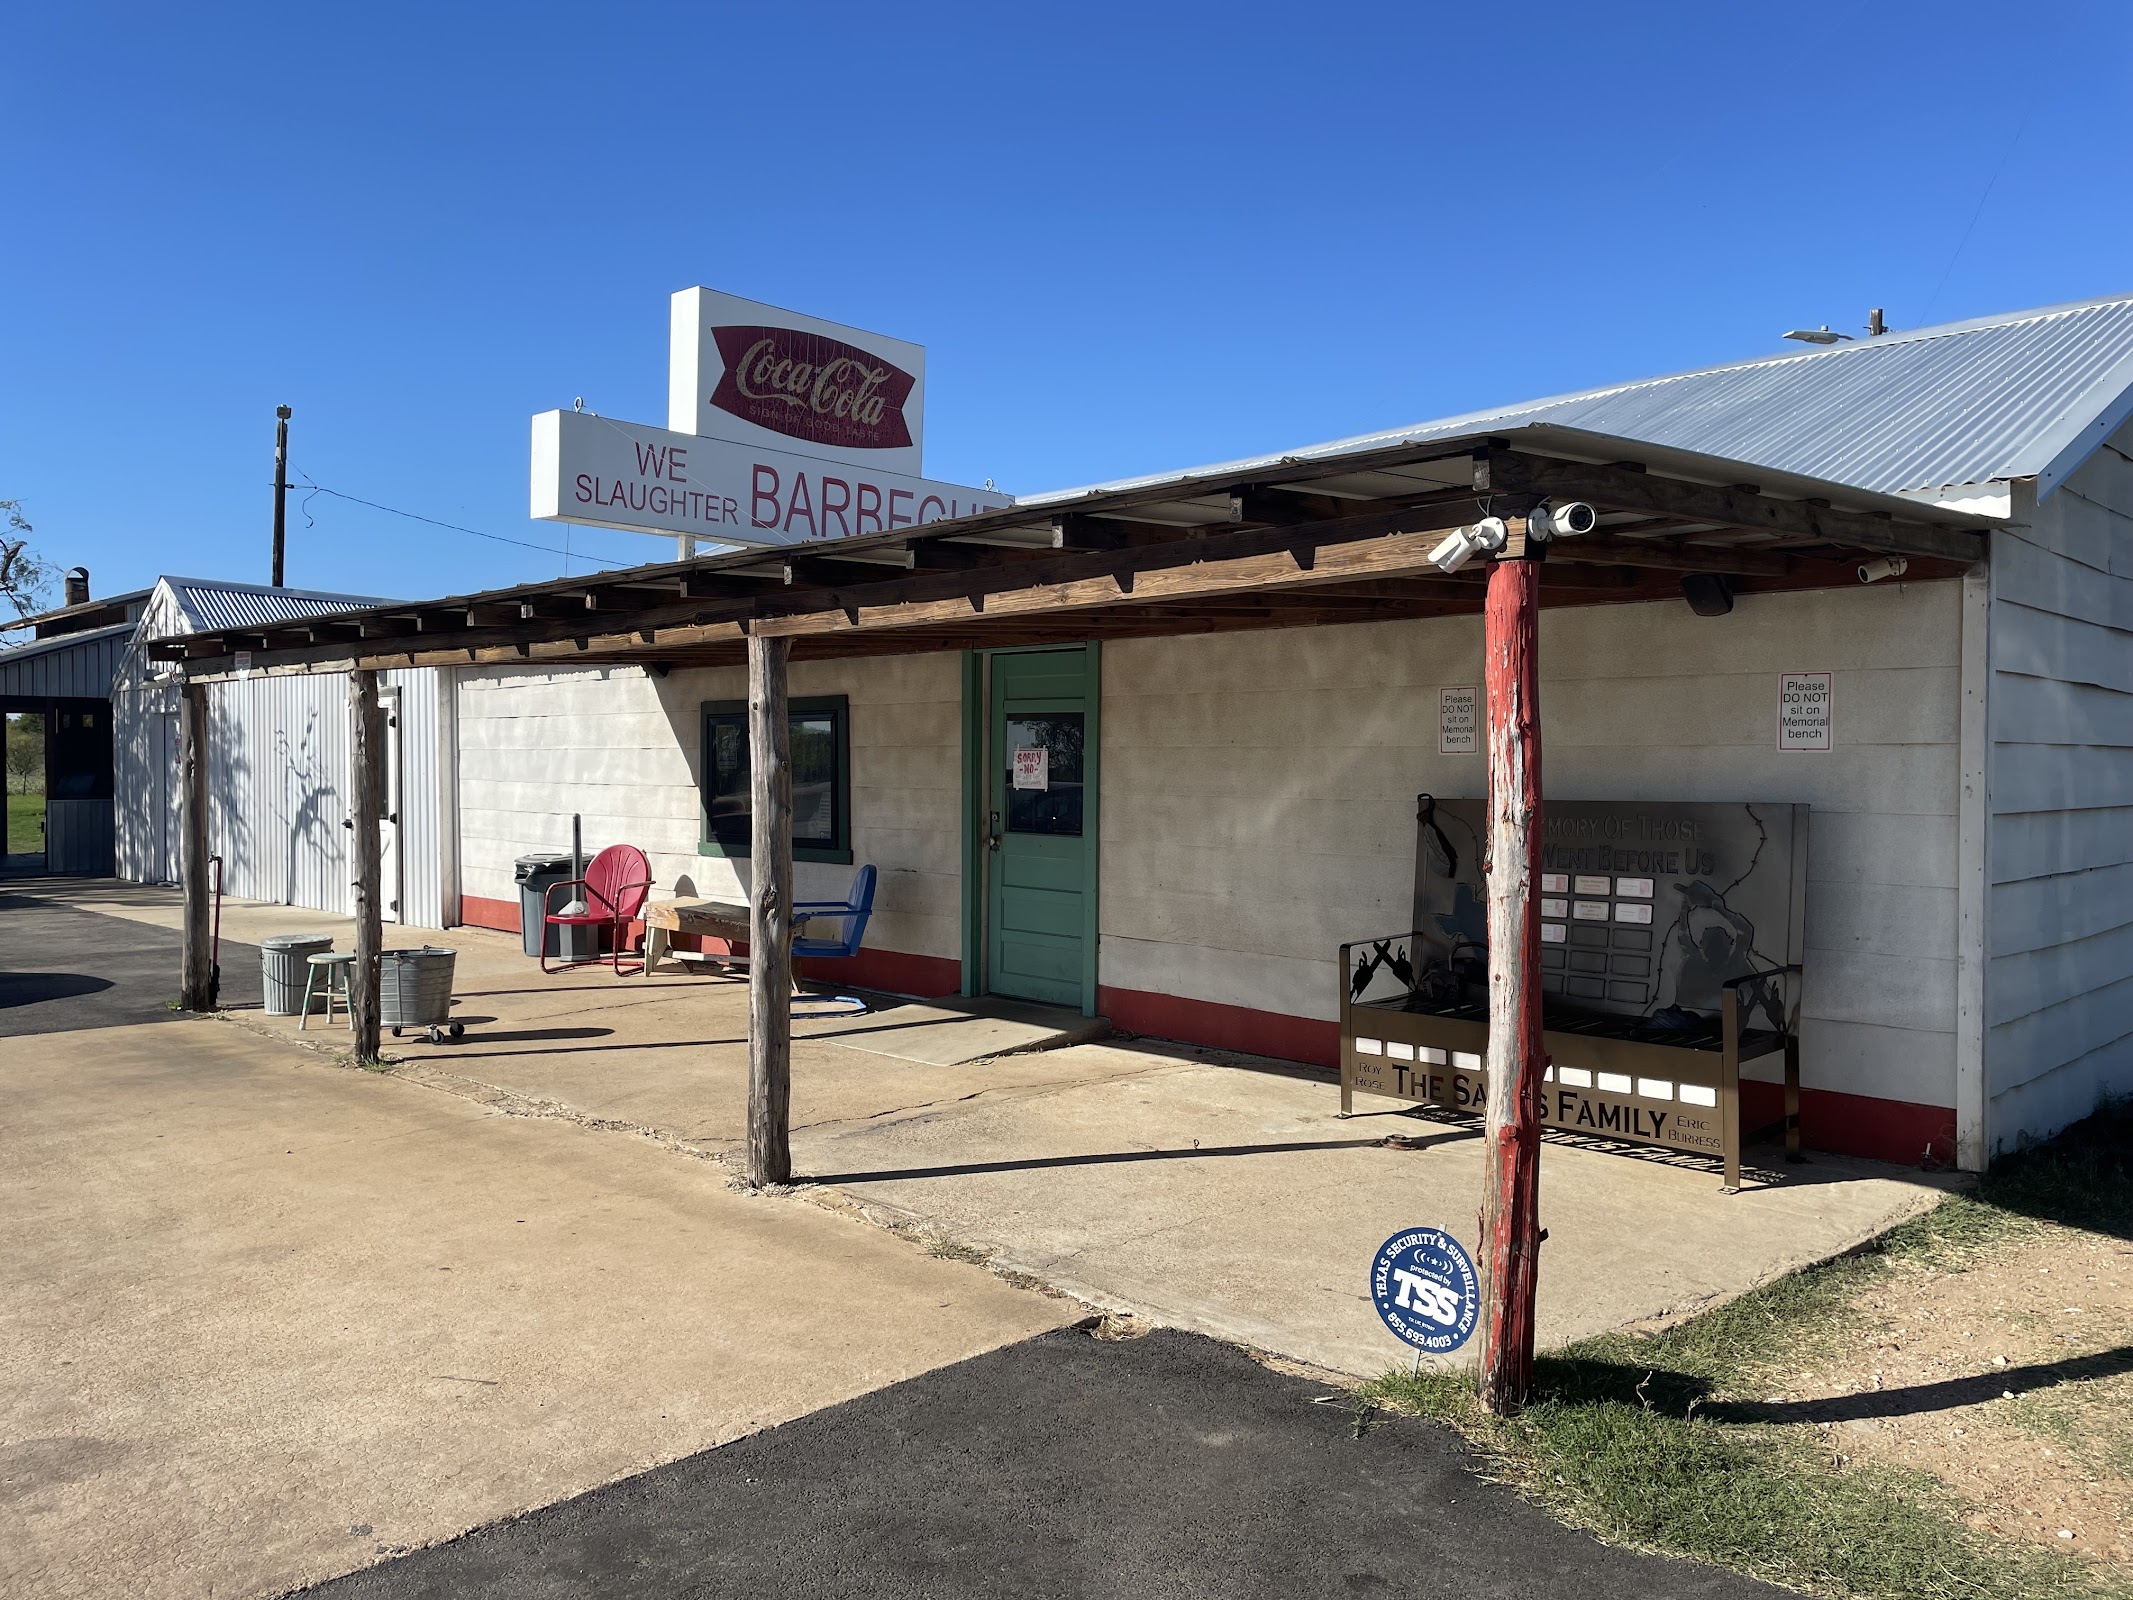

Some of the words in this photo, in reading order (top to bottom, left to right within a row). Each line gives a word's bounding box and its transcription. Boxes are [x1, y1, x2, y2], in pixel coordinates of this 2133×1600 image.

[749, 405, 779, 421] SIGN
[784, 413, 801, 424] OF
[806, 418, 840, 432] GOOD
[846, 426, 880, 441] TASTE
[635, 441, 687, 483] WE
[575, 474, 738, 525] SLAUGHTER
[1787, 681, 1825, 691] Please
[1445, 695, 1472, 704] Please
[1783, 693, 1800, 703] DO
[1803, 692, 1828, 703] NOT
[1442, 705, 1455, 714] DO
[1456, 704, 1475, 713] NOT
[1790, 705, 1803, 715] sit
[1806, 706, 1820, 715] on
[1447, 715, 1457, 724] sit
[1458, 716, 1469, 724] on
[1782, 716, 1828, 727] Memorial
[1442, 725, 1475, 734] Memorial
[1788, 728, 1822, 739] bench
[1446, 735, 1471, 744] bench
[1391, 1063, 1445, 1101] THE
[1558, 1090, 1668, 1139] FAMILY
[1410, 1264, 1443, 1282] protected
[1443, 1276, 1452, 1287] by
[1376, 1257, 1391, 1298] TEXAS
[1386, 1233, 1437, 1259] SECURITY
[1437, 1237, 1447, 1250] &
[1446, 1244, 1475, 1334] SURVEILLANCE
[1393, 1267, 1459, 1326] TSS
[1387, 1312, 1452, 1348] 855.693.4003
